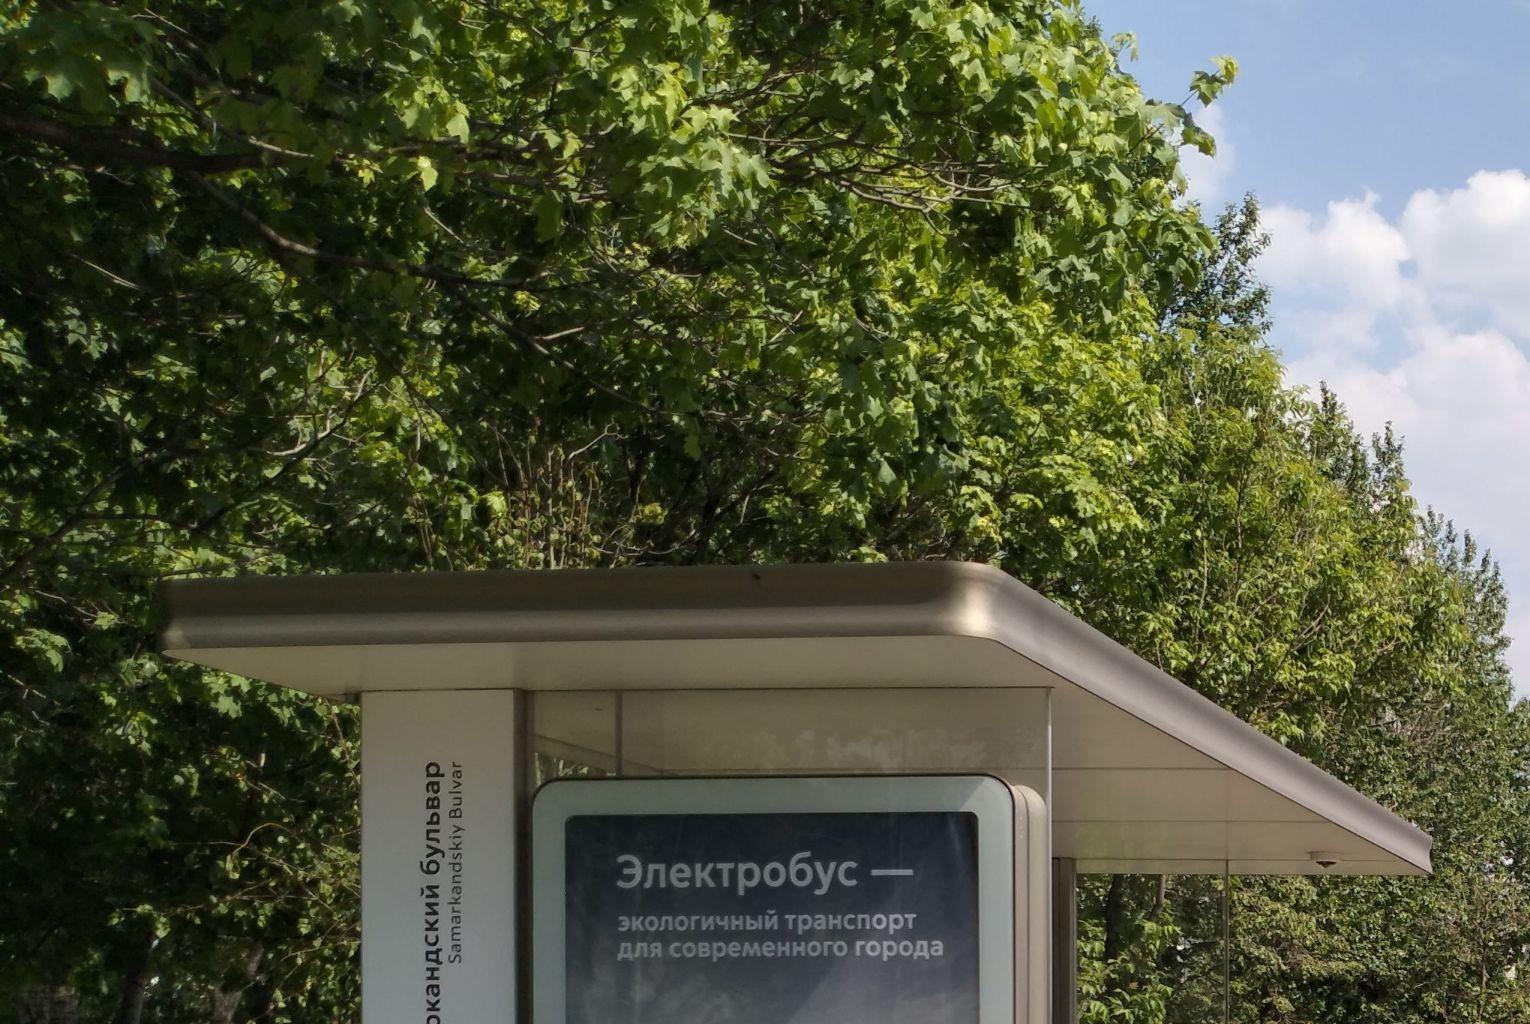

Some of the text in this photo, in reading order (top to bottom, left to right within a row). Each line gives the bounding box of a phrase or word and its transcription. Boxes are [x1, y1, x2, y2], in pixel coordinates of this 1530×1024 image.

[420, 761, 445, 875] бульвар
[448, 761, 465, 964] Samarkandskiy Bulvar
[616, 851, 858, 896] Электробус
[617, 909, 917, 935] экологичный транспорт
[617, 939, 944, 961] для современного города
